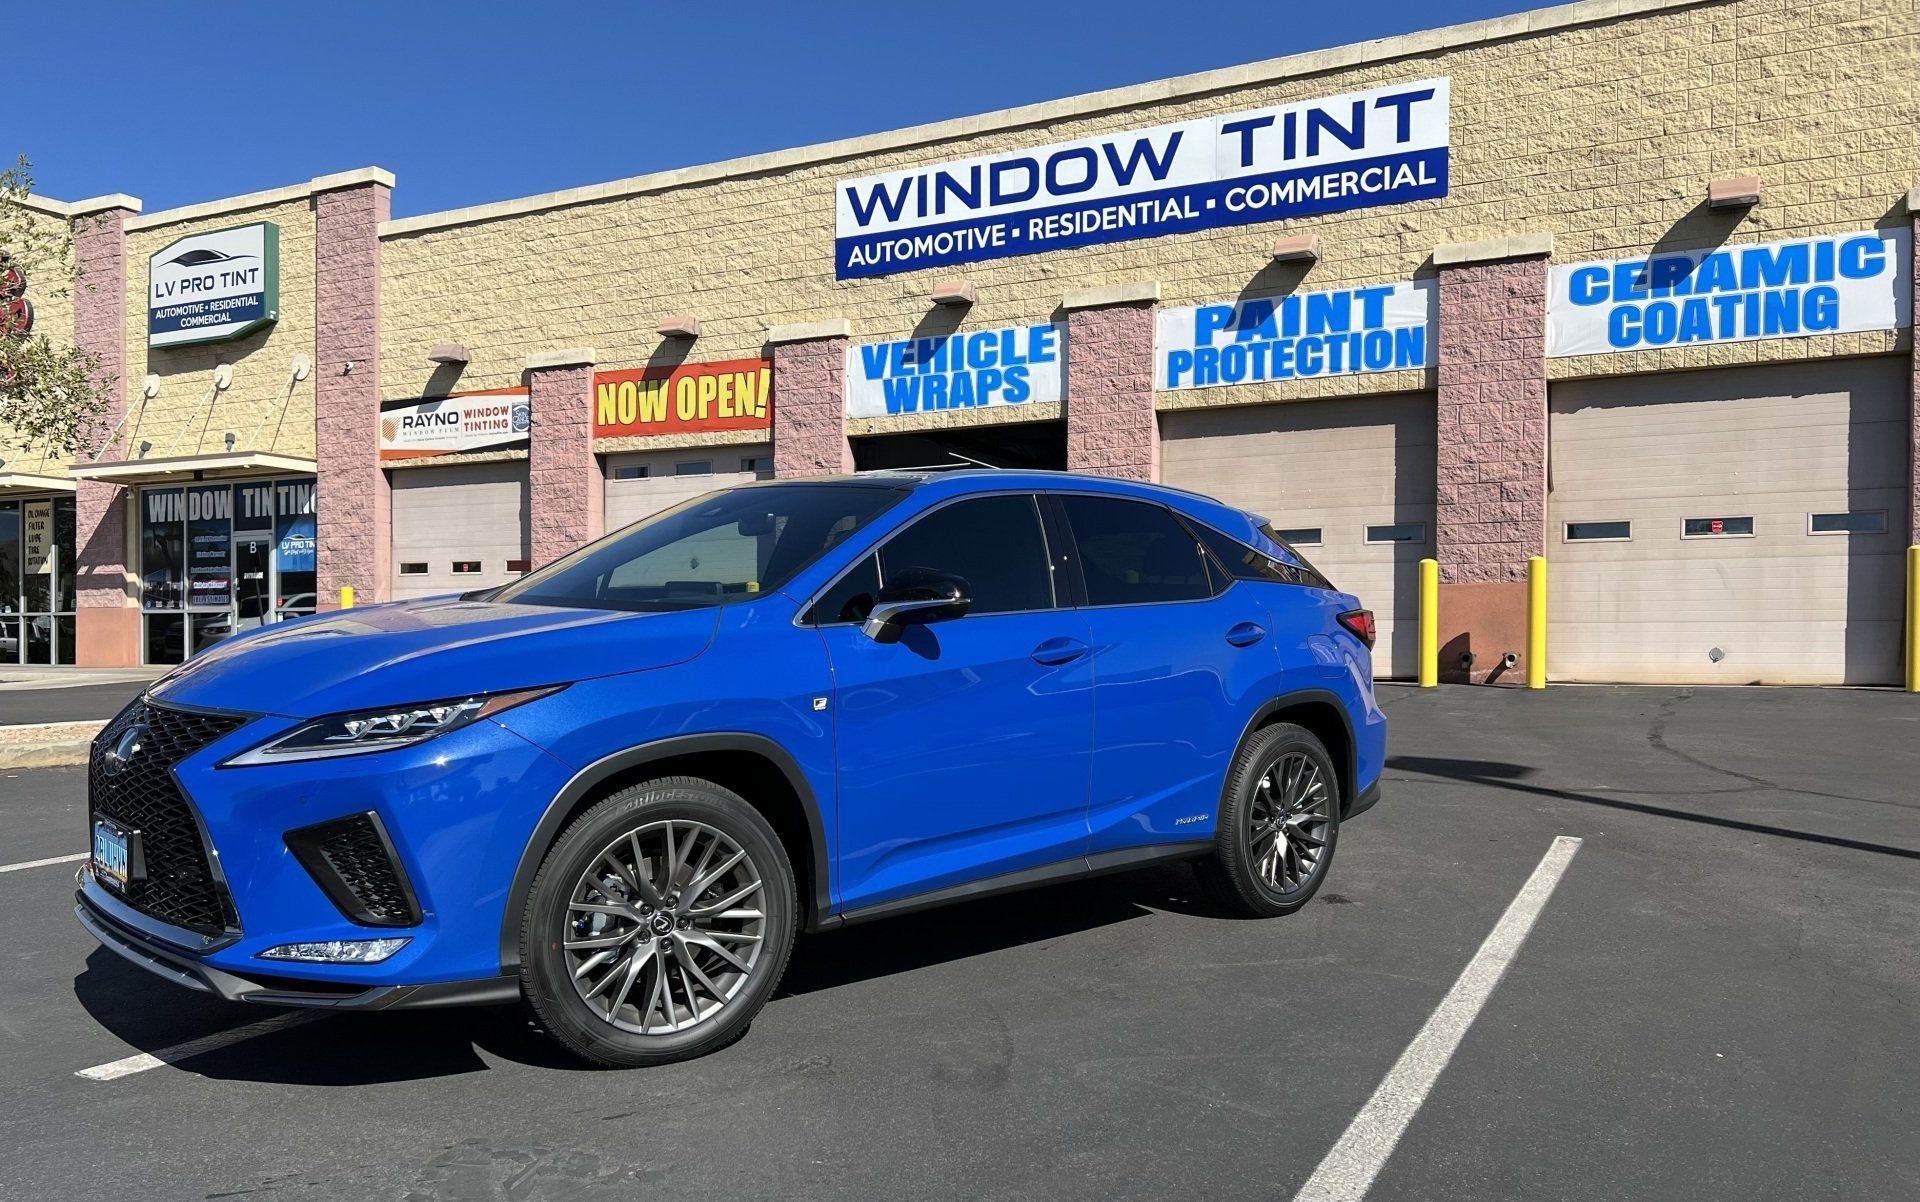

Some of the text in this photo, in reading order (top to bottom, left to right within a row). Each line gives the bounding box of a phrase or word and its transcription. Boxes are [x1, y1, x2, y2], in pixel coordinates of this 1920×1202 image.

[846, 88, 1436, 227] WINDOW TINT
[847, 160, 1437, 268] AUTOMOTIVE RESIDENTIAL COMMERCIAL
[155, 268, 259, 298] LV PRO TINT
[1568, 236, 1886, 307] CERAMIC
[155, 296, 259, 319] AUTOMOTIVE RESIDENTIAL
[180, 312, 232, 327] COMMERCIAL
[1194, 285, 1395, 348] PAINT
[1608, 284, 1840, 348] COATING
[861, 324, 1056, 380] VEHICLE
[1167, 325, 1426, 389] PROTECTION
[463, 405, 510, 419] WINDOW
[596, 367, 771, 427] NOW OPEN!
[882, 365, 1031, 415] WRAPS
[402, 411, 460, 429] RAYNO
[463, 419, 509, 432] TINTING
[148, 490, 232, 523] WINDOW
[250, 541, 257, 554] B
